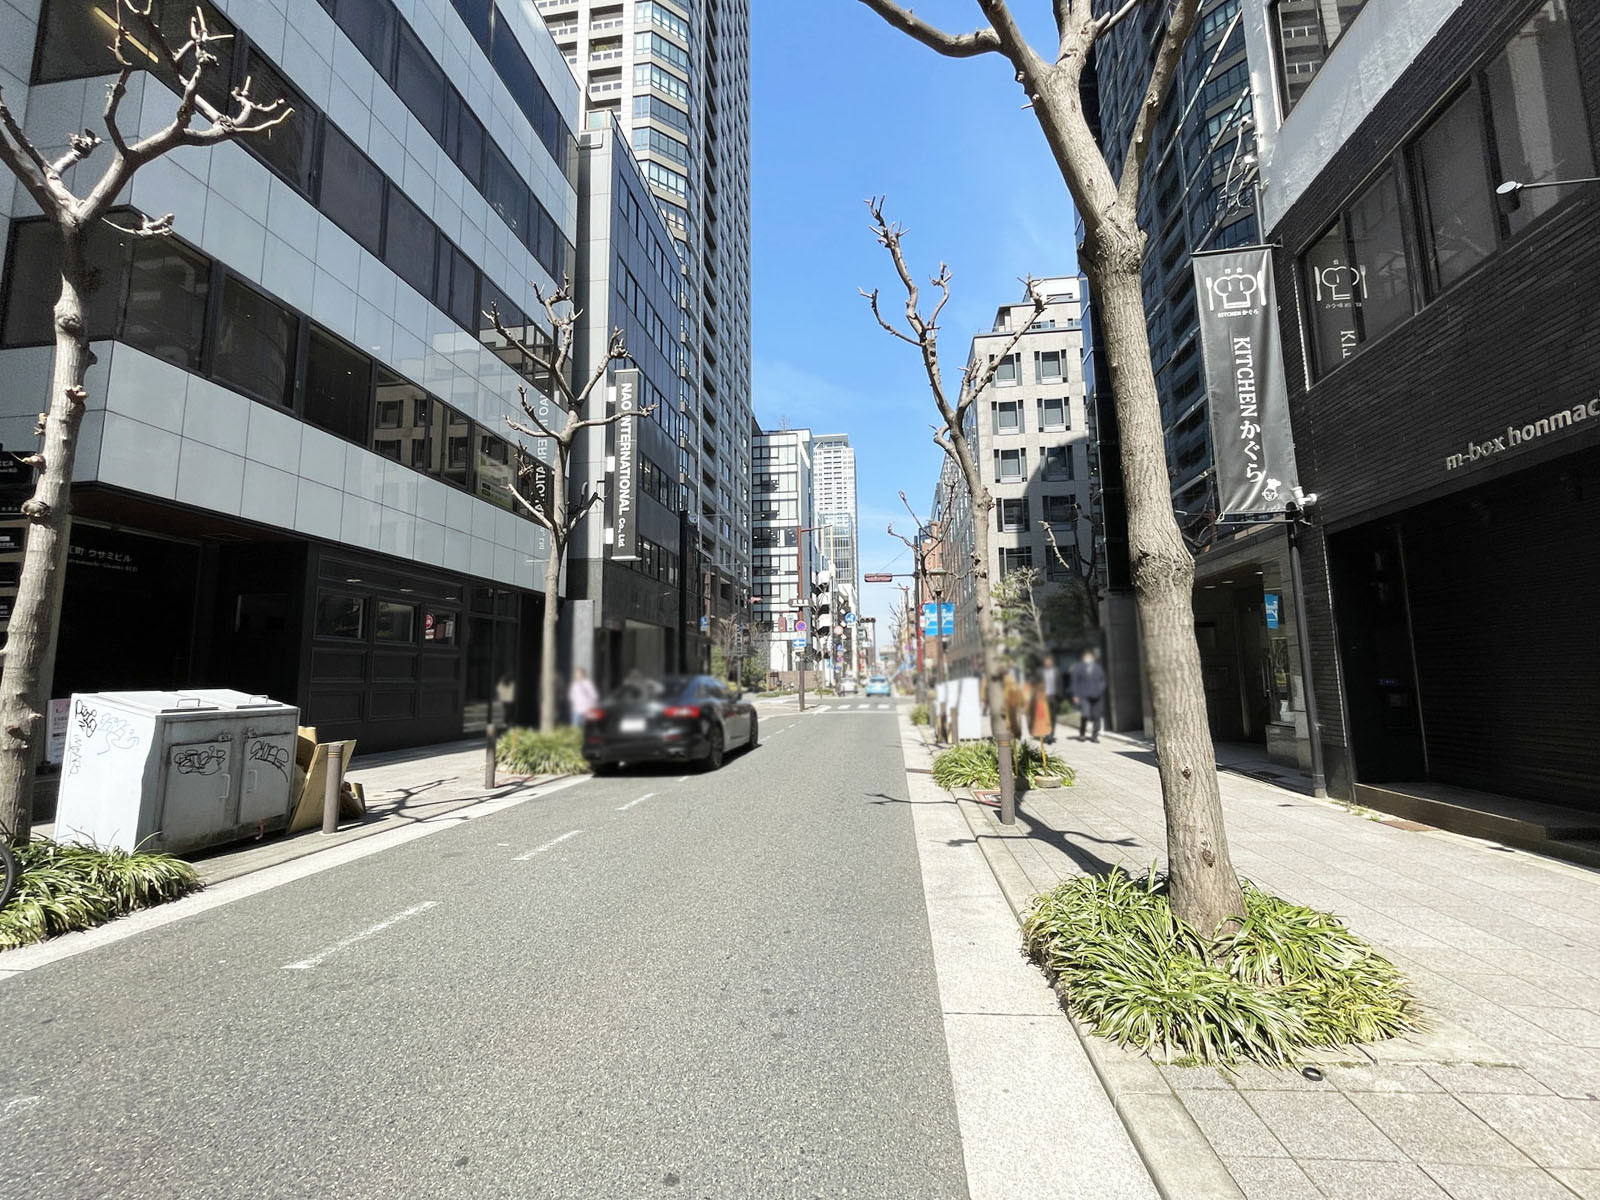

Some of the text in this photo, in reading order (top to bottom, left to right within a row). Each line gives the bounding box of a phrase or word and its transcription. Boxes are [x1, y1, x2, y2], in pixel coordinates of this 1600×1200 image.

[620, 382, 632, 411] NAO
[1233, 336, 1263, 483] KITCHEN かぐら
[1445, 392, 1600, 471] m-box honmac
